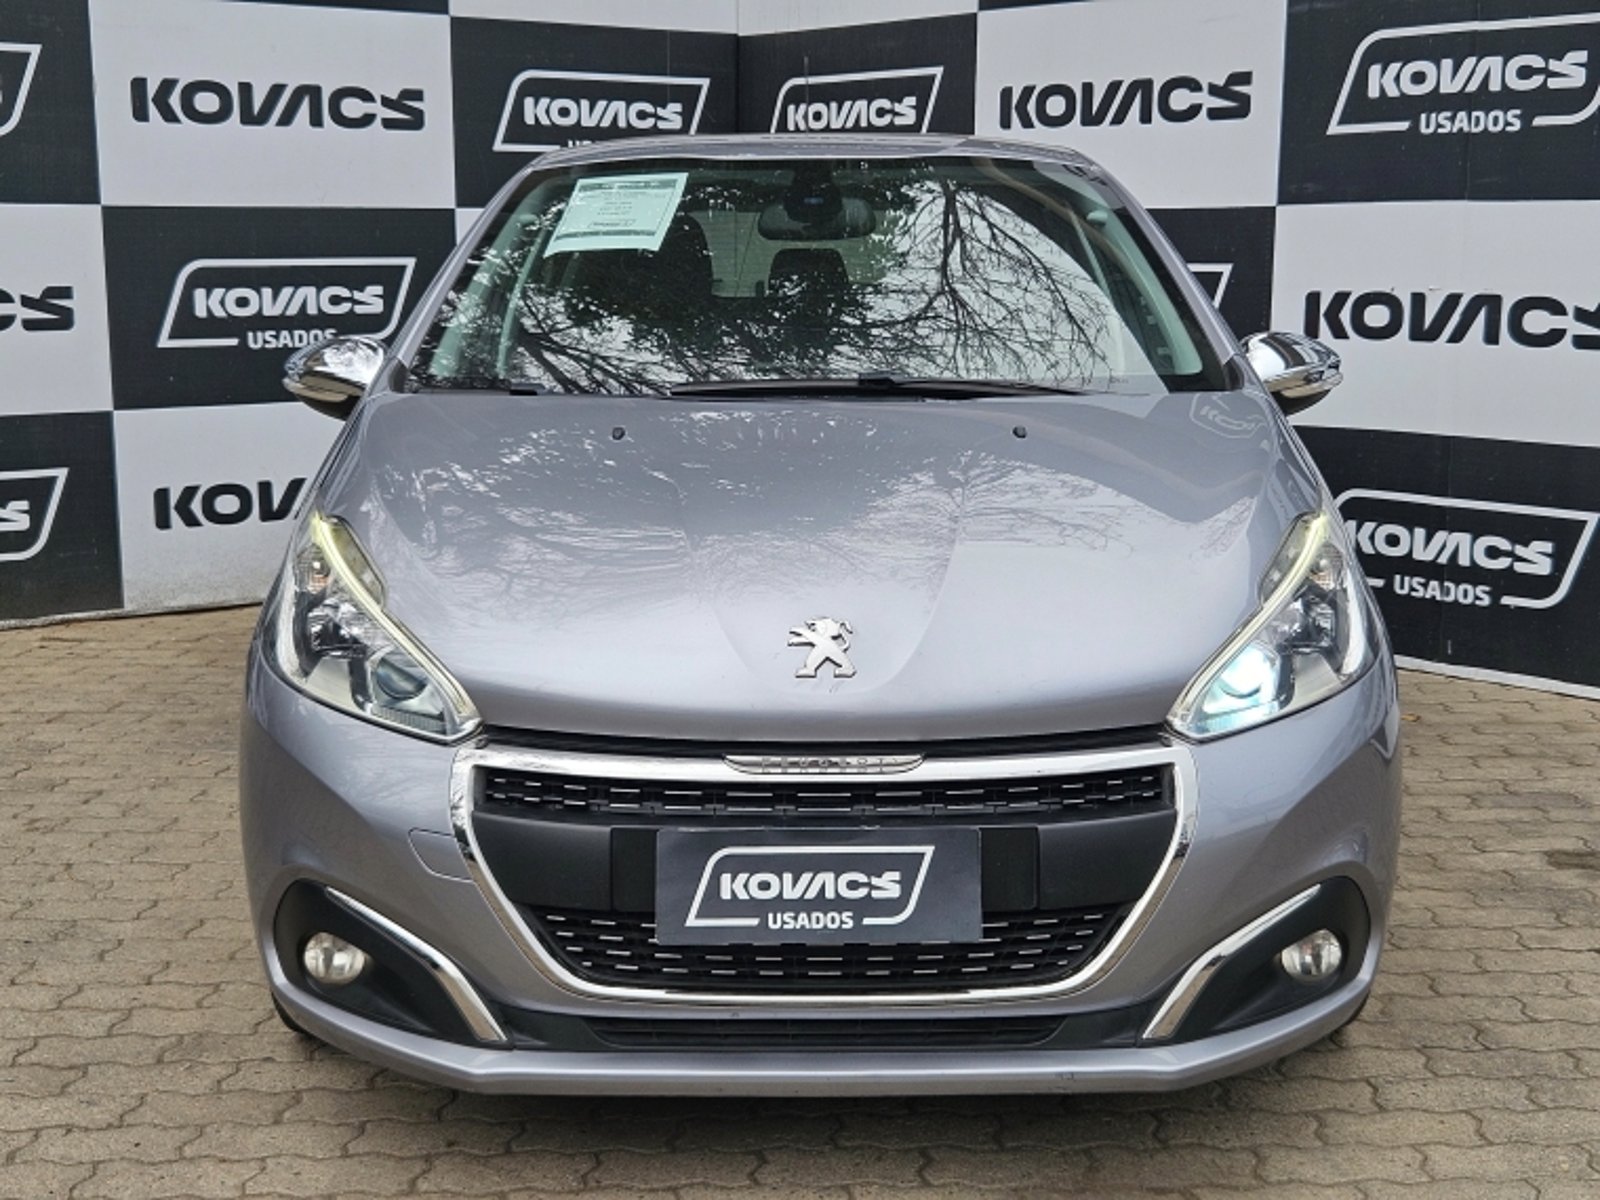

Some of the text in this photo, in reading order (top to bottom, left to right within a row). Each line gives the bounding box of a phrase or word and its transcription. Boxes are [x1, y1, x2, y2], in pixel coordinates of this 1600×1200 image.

[1367, 50, 1588, 99] KOVACS
[131, 77, 425, 131] KOVACS
[523, 96, 683, 130] KOVACS
[787, 96, 917, 131] KOVACS
[1000, 71, 1253, 129] KOVACS
[1419, 109, 1522, 134] USADOS
[193, 285, 384, 318] KOVACS
[153, 477, 307, 530] KOV
[1344, 519, 1555, 576] KOVACS
[1393, 574, 1492, 607] USADOS
[719, 871, 902, 900] KOVACS
[767, 911, 855, 930] USADOS
